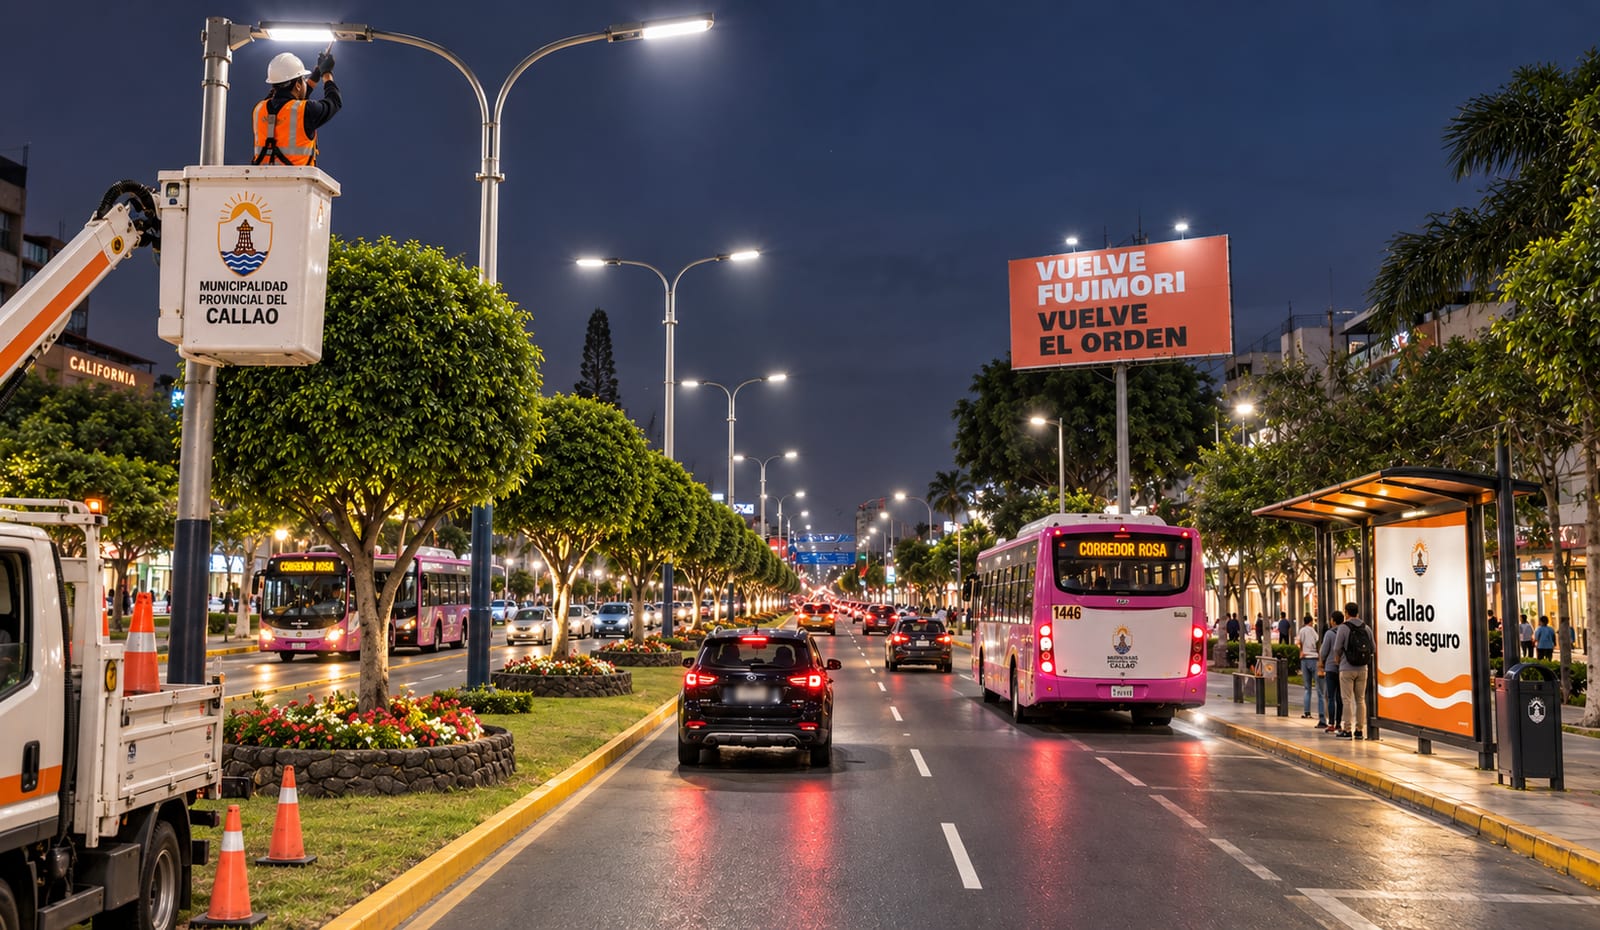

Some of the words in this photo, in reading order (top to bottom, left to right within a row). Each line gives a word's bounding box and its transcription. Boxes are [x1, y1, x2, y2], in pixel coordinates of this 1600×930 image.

[1036, 251, 1146, 281] VUELVE
[199, 280, 288, 292] MUNICIPALIDAD
[1037, 271, 1185, 306] FUJIMORI
[199, 294, 264, 305] PROVINCIAL
[266, 294, 287, 305] DEL
[206, 307, 279, 325] CALLAO
[1037, 303, 1148, 332] VUELVE
[1039, 334, 1072, 356] EL
[1080, 326, 1187, 354] ORDEN
[69, 355, 136, 387] CALIFORNIA
[1079, 541, 1135, 557] CORREDOR
[1138, 543, 1168, 557] ROSA
[1385, 577, 1403, 596] Un
[1053, 606, 1081, 620] 1446
[1385, 598, 1435, 623] Callao
[1386, 626, 1412, 647] más
[1415, 630, 1460, 653] seguro
